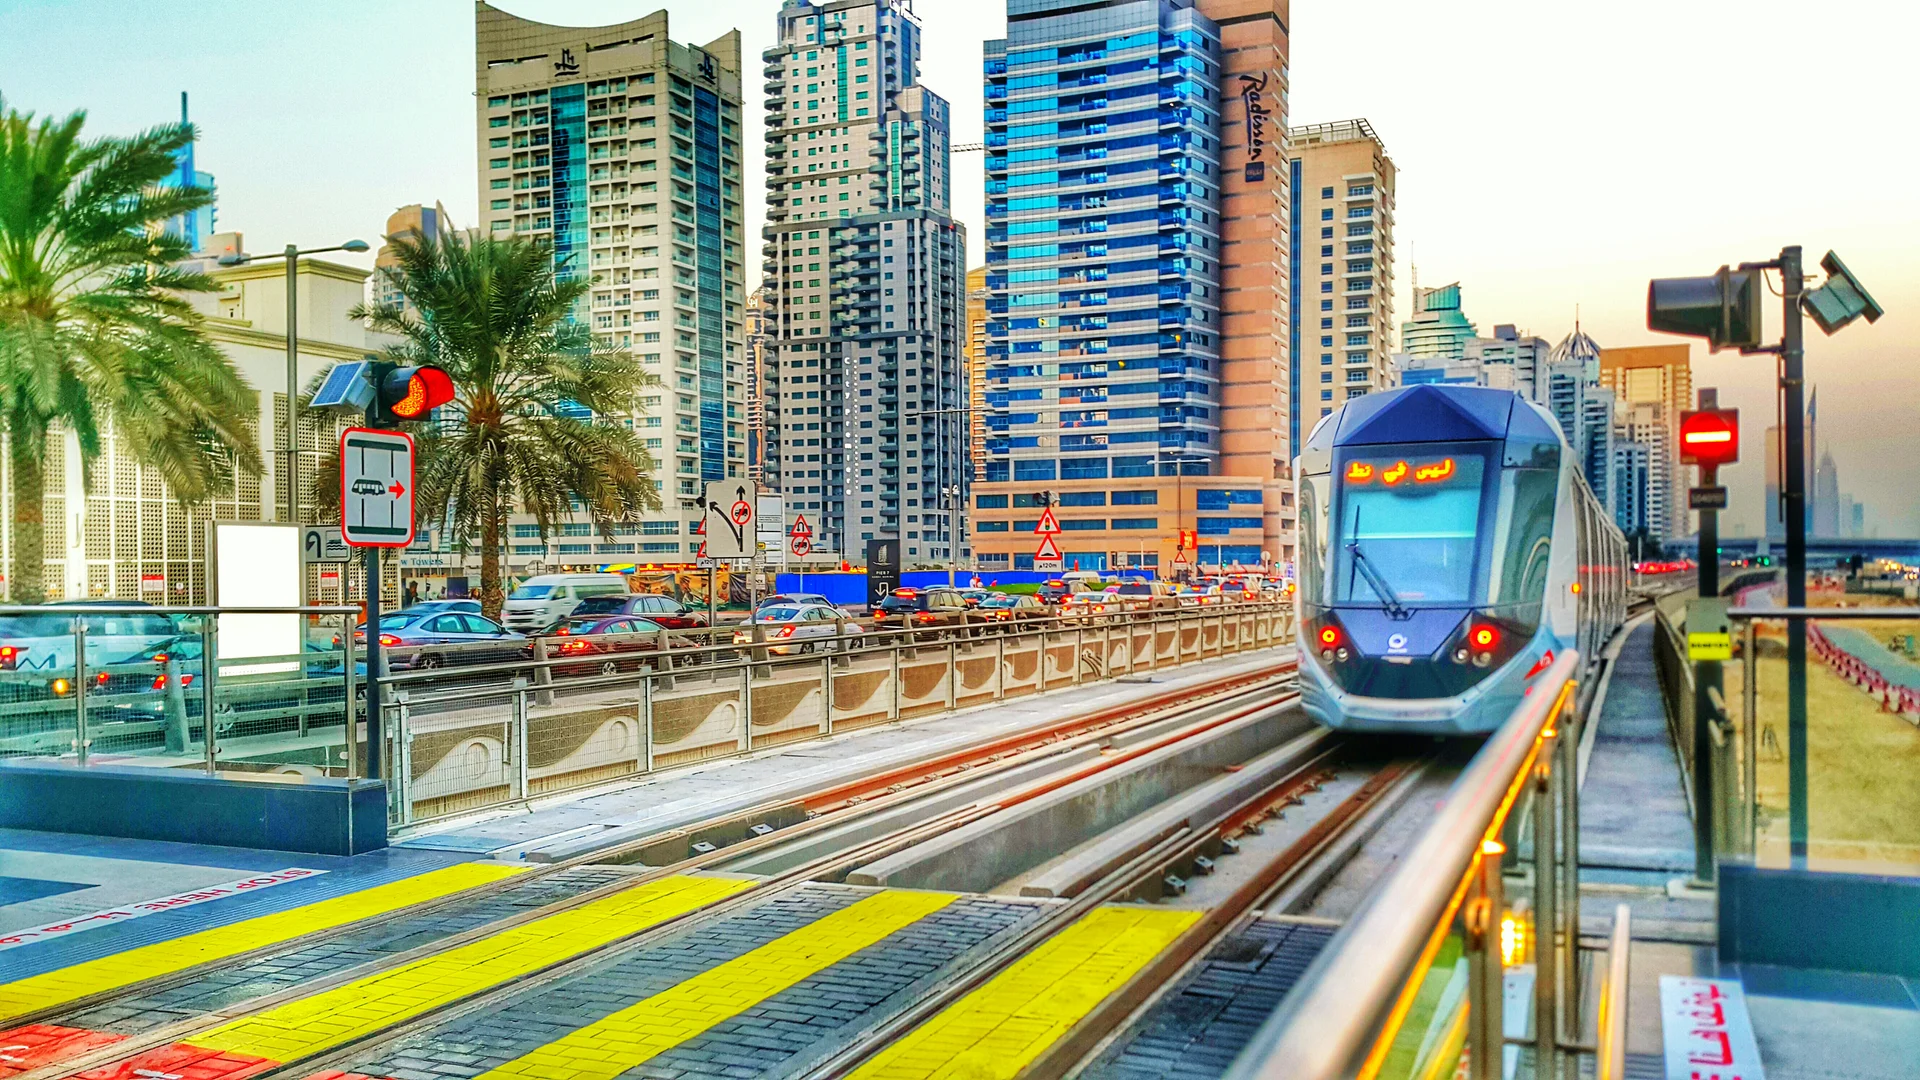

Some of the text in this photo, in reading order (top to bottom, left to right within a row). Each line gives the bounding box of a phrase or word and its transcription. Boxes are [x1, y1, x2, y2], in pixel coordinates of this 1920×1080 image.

[1239, 72, 1271, 161] Radisson
[134, 869, 312, 911] STOP HERE
